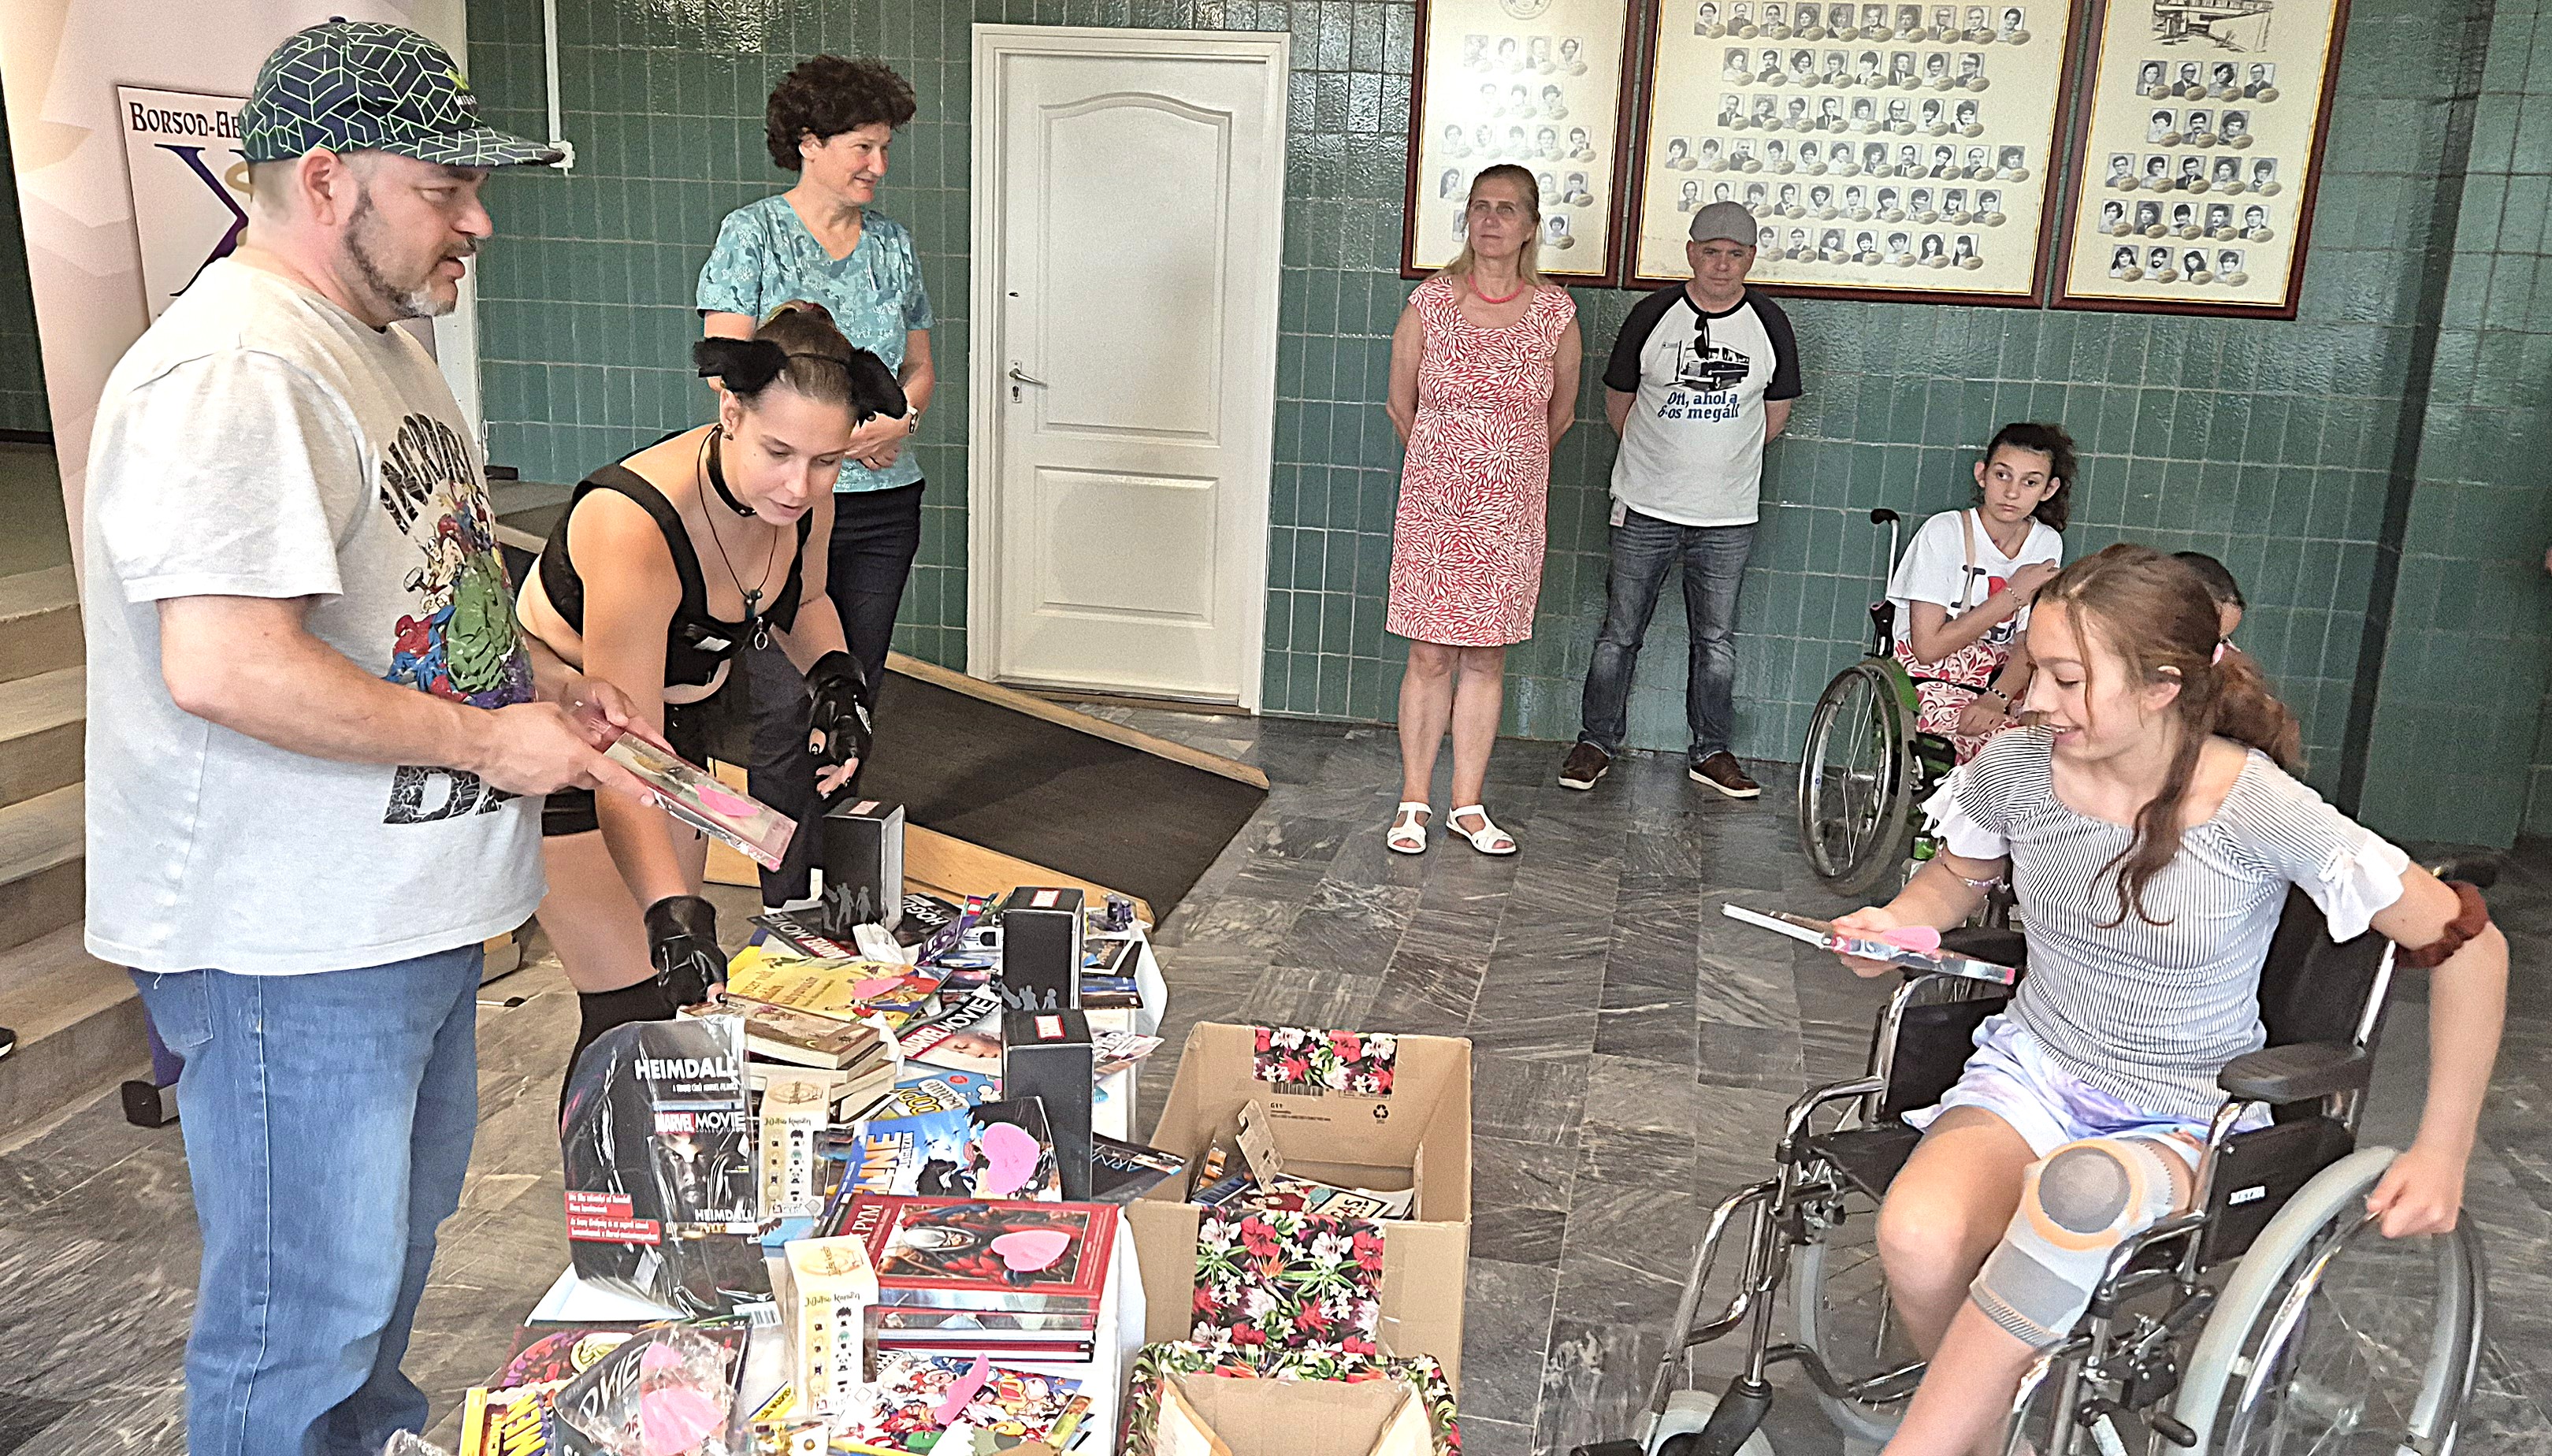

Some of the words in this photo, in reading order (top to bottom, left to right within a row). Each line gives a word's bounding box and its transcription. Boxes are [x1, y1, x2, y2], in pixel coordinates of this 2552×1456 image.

[1693, 391, 1727, 406] ahol
[1729, 394, 1738, 405] a
[1687, 403, 1740, 422] megáll
[933, 998, 997, 1033] MOVIE
[633, 1056, 739, 1080] HEIMDALL
[654, 1112, 696, 1133] MARVEL
[696, 1111, 746, 1132] MOVIE
[694, 1208, 756, 1223] HEIMDALL
